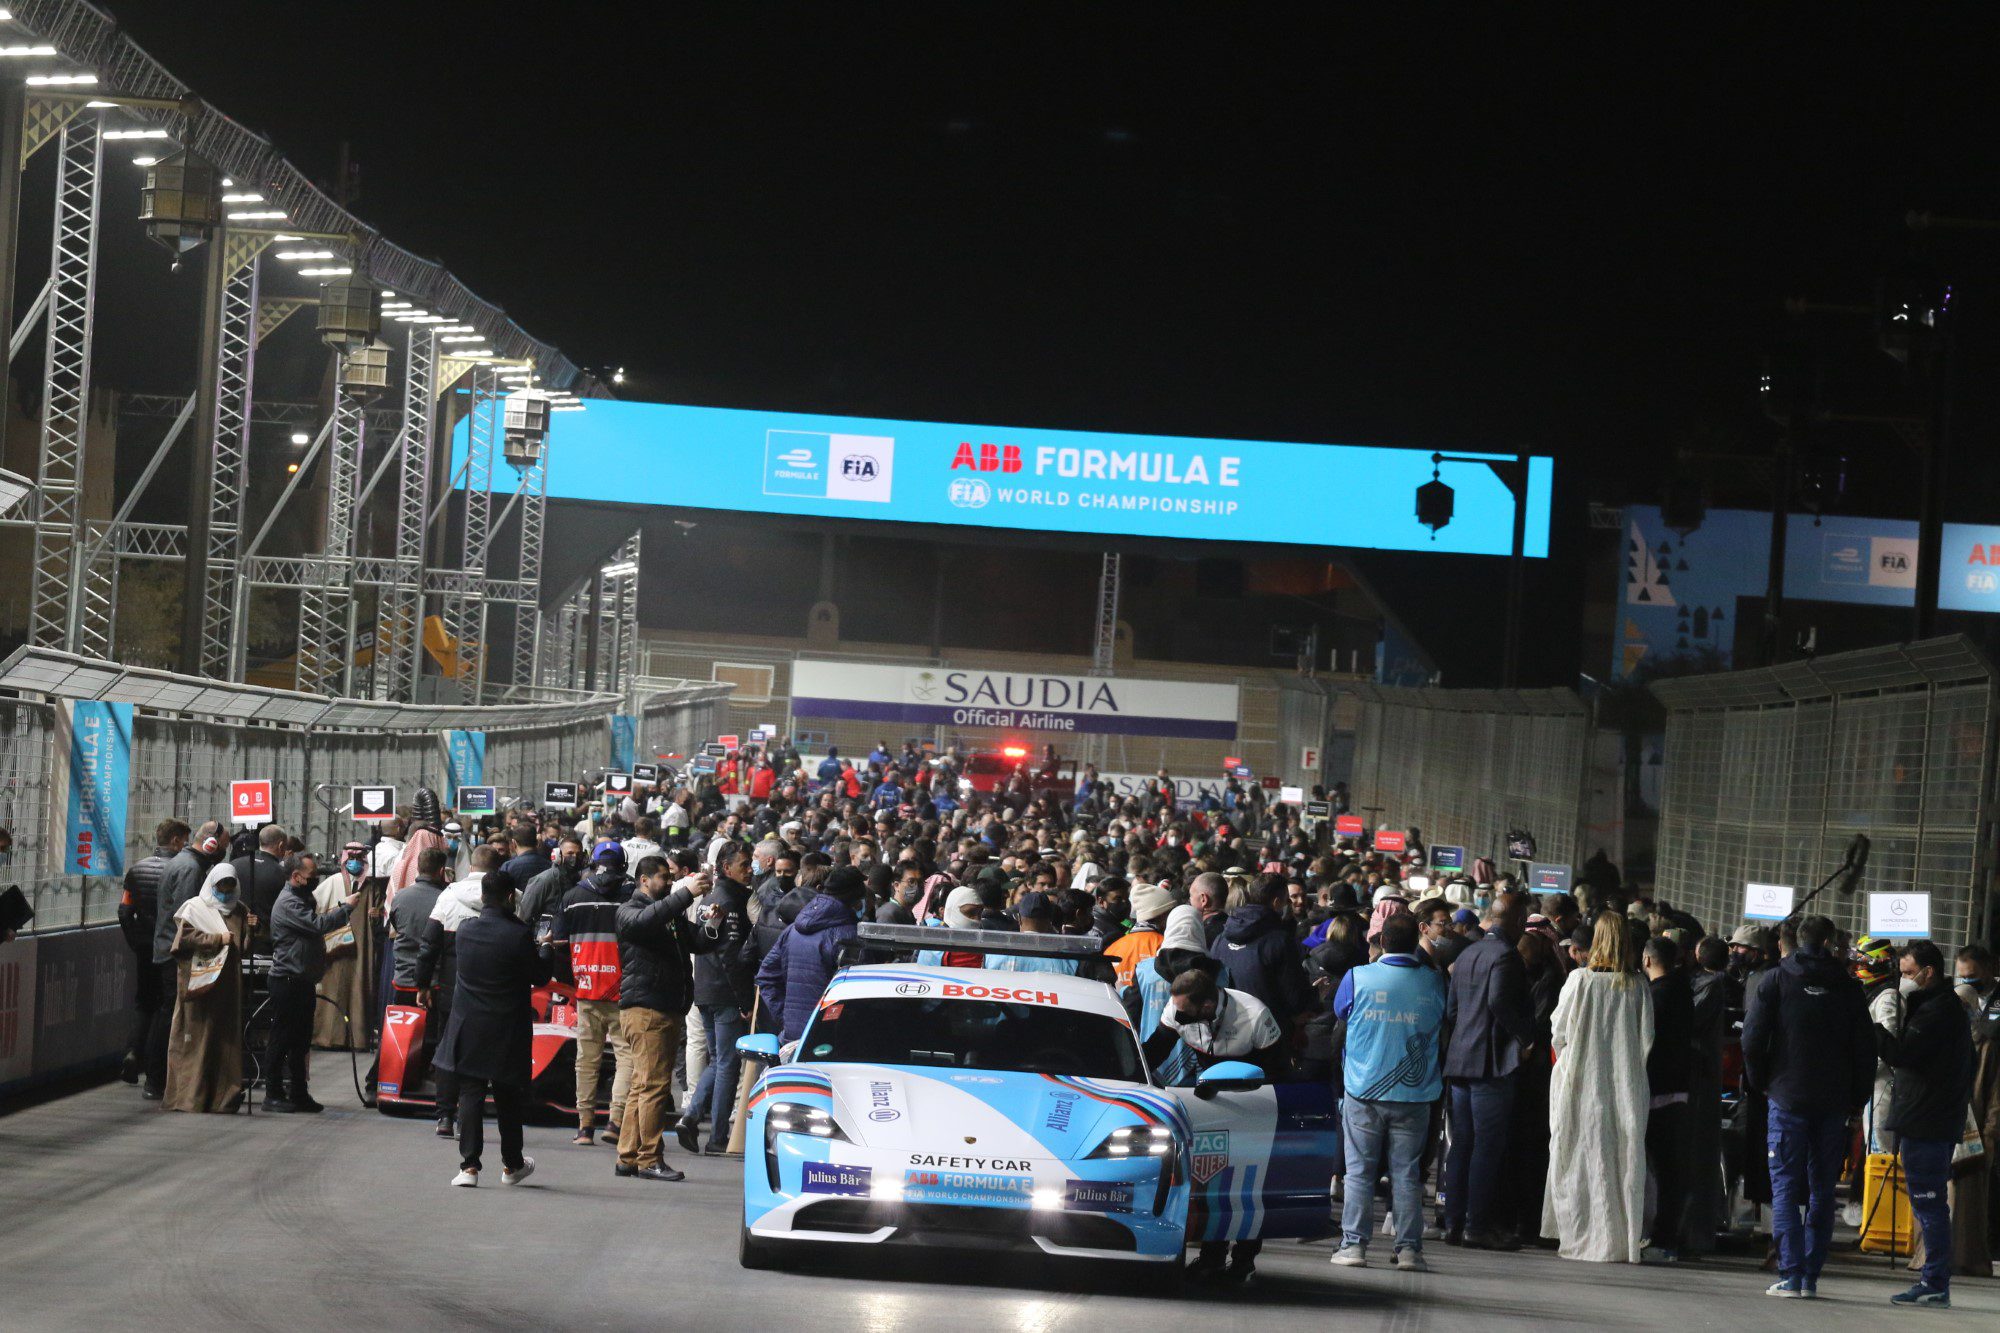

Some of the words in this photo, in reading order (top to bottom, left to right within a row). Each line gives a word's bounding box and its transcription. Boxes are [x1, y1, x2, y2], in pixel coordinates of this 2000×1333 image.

[774, 470, 812, 479] FORMULA
[951, 442, 1023, 473] ABB
[1036, 446, 1210, 485] FORMULA
[1220, 456, 1241, 487] E
[998, 488, 1070, 506] WORLD
[1079, 493, 1238, 515] CHAMPIONSHIP
[1968, 544, 2000, 566] AB
[945, 672, 1119, 712] SAUDIA
[84, 716, 100, 728] E
[953, 709, 1014, 727] Official
[1019, 714, 1075, 731] Airline
[103, 717, 115, 803] CHAMPIONSHIP
[1306, 751, 1316, 766] F
[79, 733, 99, 826] FORMULA
[1119, 777, 1222, 799] SADIA
[77, 831, 93, 869] ABB
[588, 964, 617, 973] HOLDER
[942, 984, 1059, 1006] BOSCH
[386, 1010, 420, 1025] 27
[1364, 1010, 1385, 1021] PIT
[1387, 1012, 1419, 1024] LANE
[870, 1081, 891, 1108] Allianz
[1046, 1100, 1073, 1133] Allianz
[1193, 1134, 1224, 1151] TAG
[909, 1154, 986, 1169] SAFETY
[991, 1159, 1032, 1171] CAR
[1194, 1155, 1225, 1179] EUER
[808, 1170, 837, 1185] Julius
[840, 1173, 862, 1186] Bär
[908, 1172, 939, 1185] ABB
[944, 1174, 1017, 1191] FORMULA
[1021, 1178, 1032, 1192] E
[928, 1191, 959, 1199] WORLD
[961, 1193, 1029, 1204] CHAMPIONSHIP
[1074, 1188, 1107, 1202] Julius
[1110, 1190, 1128, 1202] Bär
